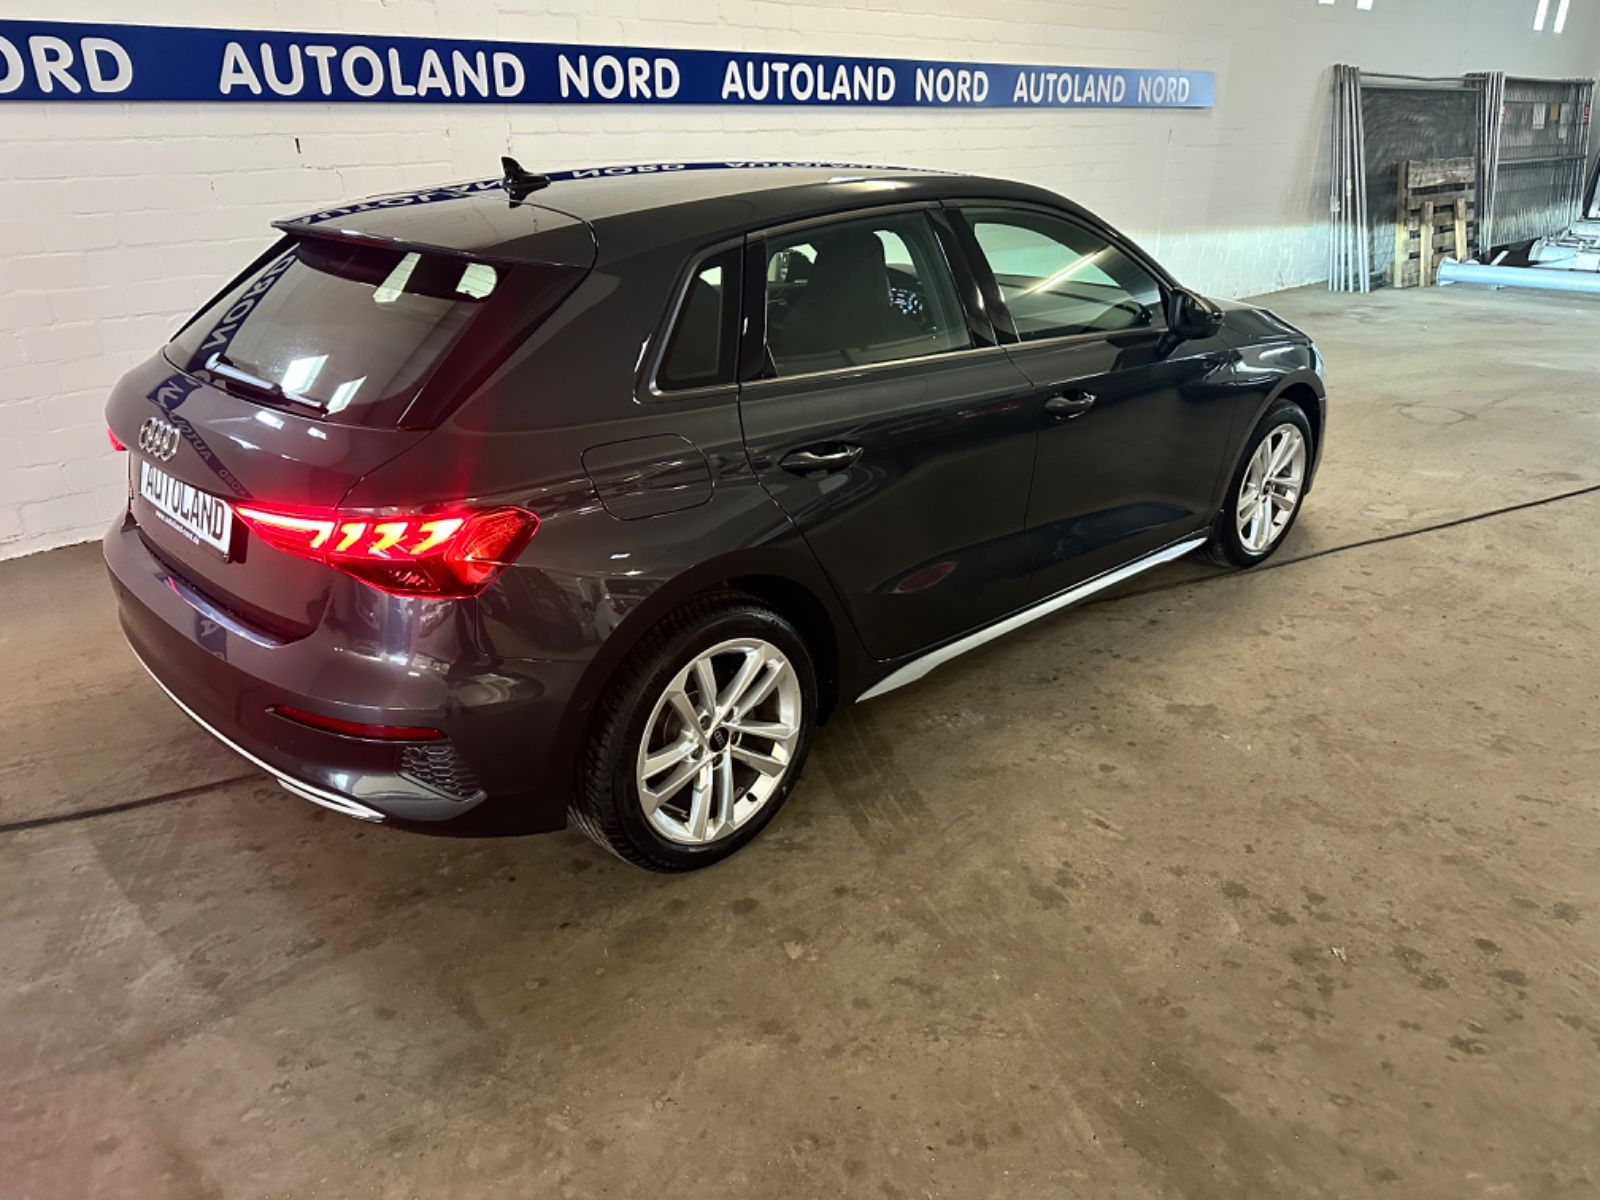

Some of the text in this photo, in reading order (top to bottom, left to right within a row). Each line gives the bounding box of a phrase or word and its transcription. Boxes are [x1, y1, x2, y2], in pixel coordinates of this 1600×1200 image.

[219, 41, 525, 98] AUTOLAND
[558, 54, 680, 99] NORD
[722, 60, 896, 101] AUTOLAND
[915, 68, 989, 103] NORD
[1013, 71, 1126, 104] AUTOLAND
[1137, 75, 1190, 104] NORD
[144, 464, 226, 541] AUTOLAND
